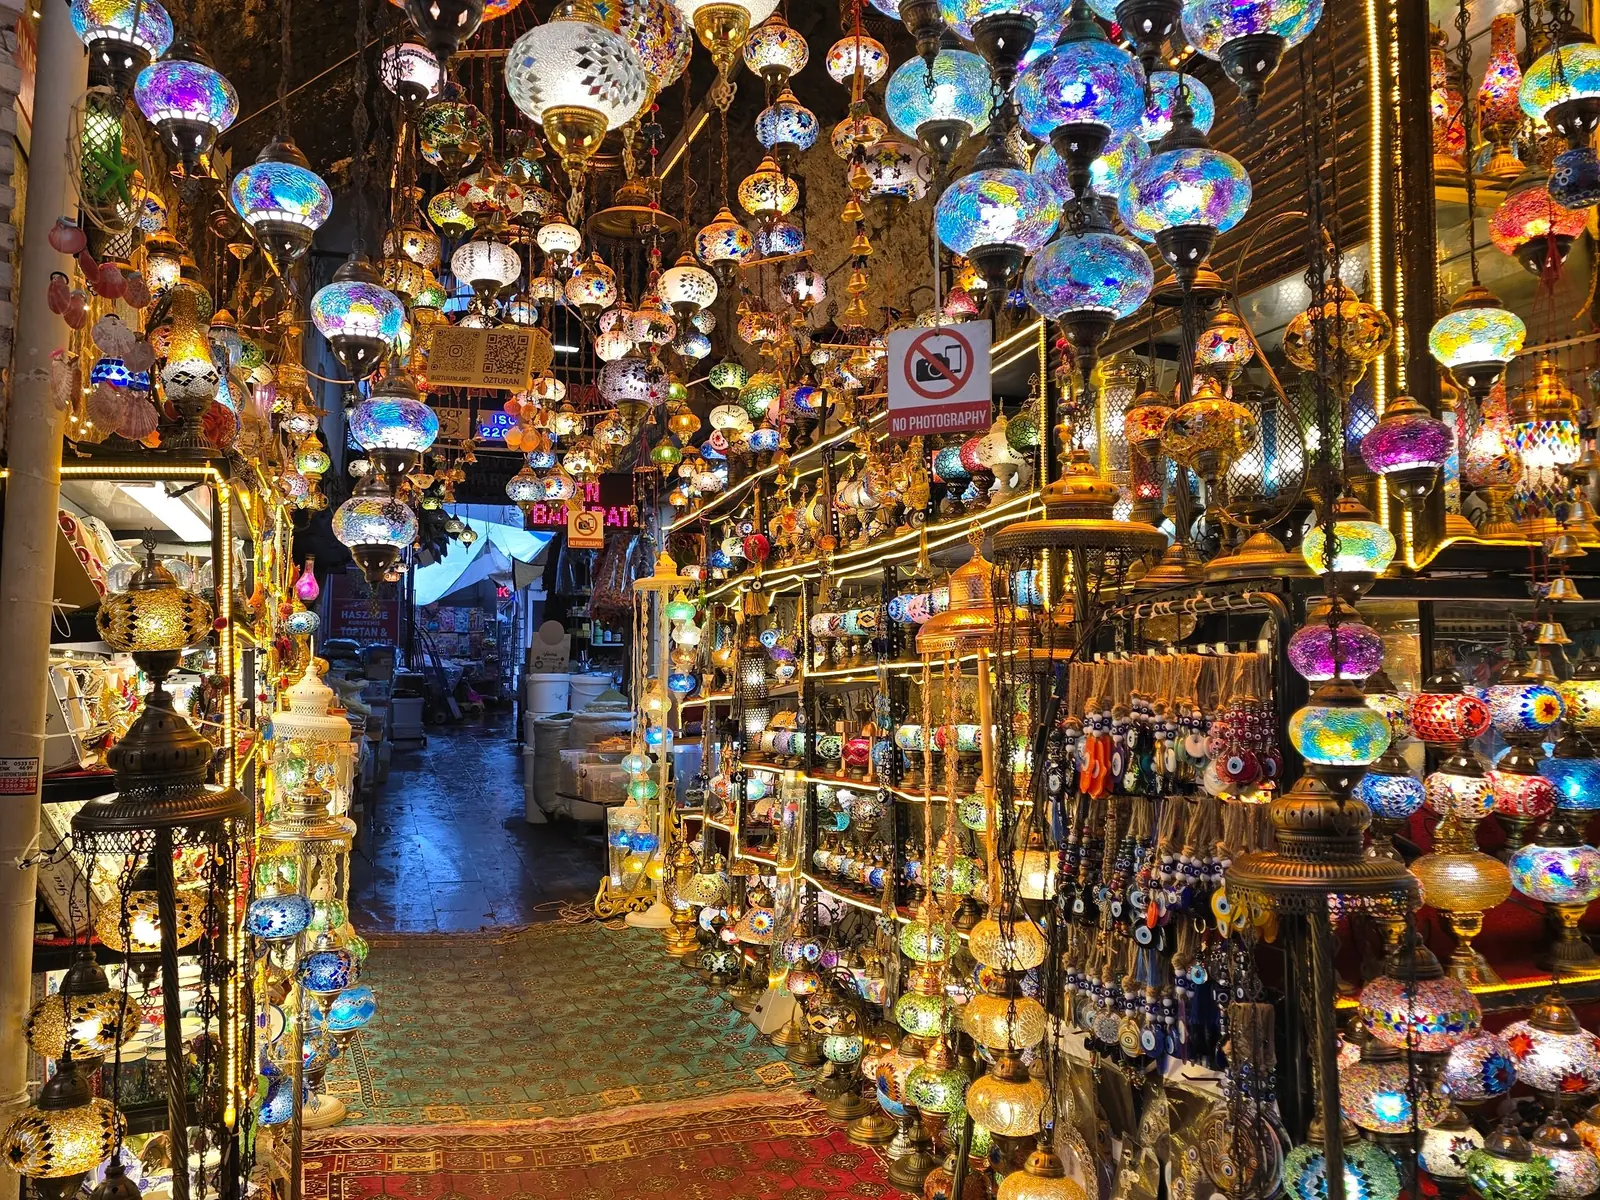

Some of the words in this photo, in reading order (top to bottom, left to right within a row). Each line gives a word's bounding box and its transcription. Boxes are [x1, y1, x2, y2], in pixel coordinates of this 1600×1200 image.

[482, 375, 520, 386] ÖZTURAN
[892, 417, 907, 432] NO
[909, 409, 987, 431] PHOTOGRAPHY
[340, 627, 378, 637] TOPTAN
[380, 627, 388, 637] &
